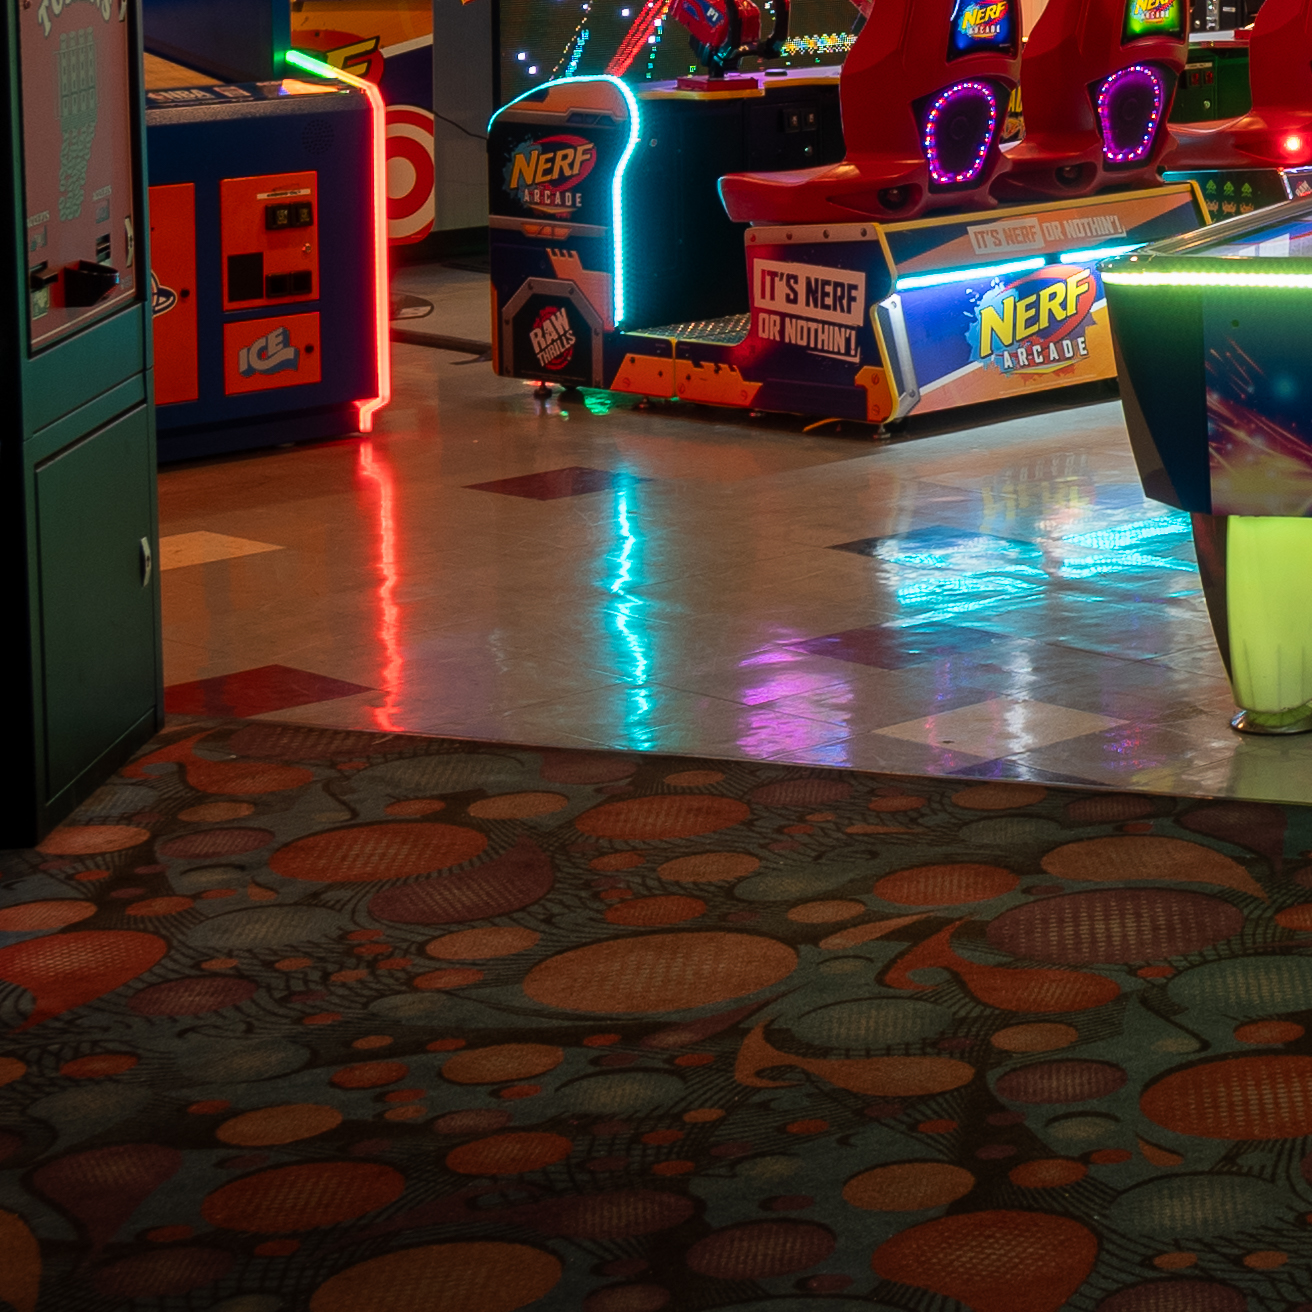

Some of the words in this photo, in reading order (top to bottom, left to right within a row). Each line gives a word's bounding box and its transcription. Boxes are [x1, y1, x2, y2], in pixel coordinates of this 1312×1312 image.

[706, 6, 720, 23] P1
[961, 1, 1009, 30] NERF
[509, 143, 595, 189] NERF
[523, 189, 582, 207] ARCADE
[972, 228, 999, 252] IT'S
[1002, 223, 1039, 248] NERF
[1042, 222, 1061, 242] OR
[759, 265, 799, 307] IT'S
[803, 275, 858, 316] NERF
[528, 306, 571, 351] RAW
[977, 268, 1093, 359] NERF
[238, 326, 299, 378] ICE
[536, 329, 577, 370] THRILLS
[758, 315, 780, 343] OR
[783, 322, 859, 359] NOTHIN'!
[1003, 335, 1087, 371] ARCADE
